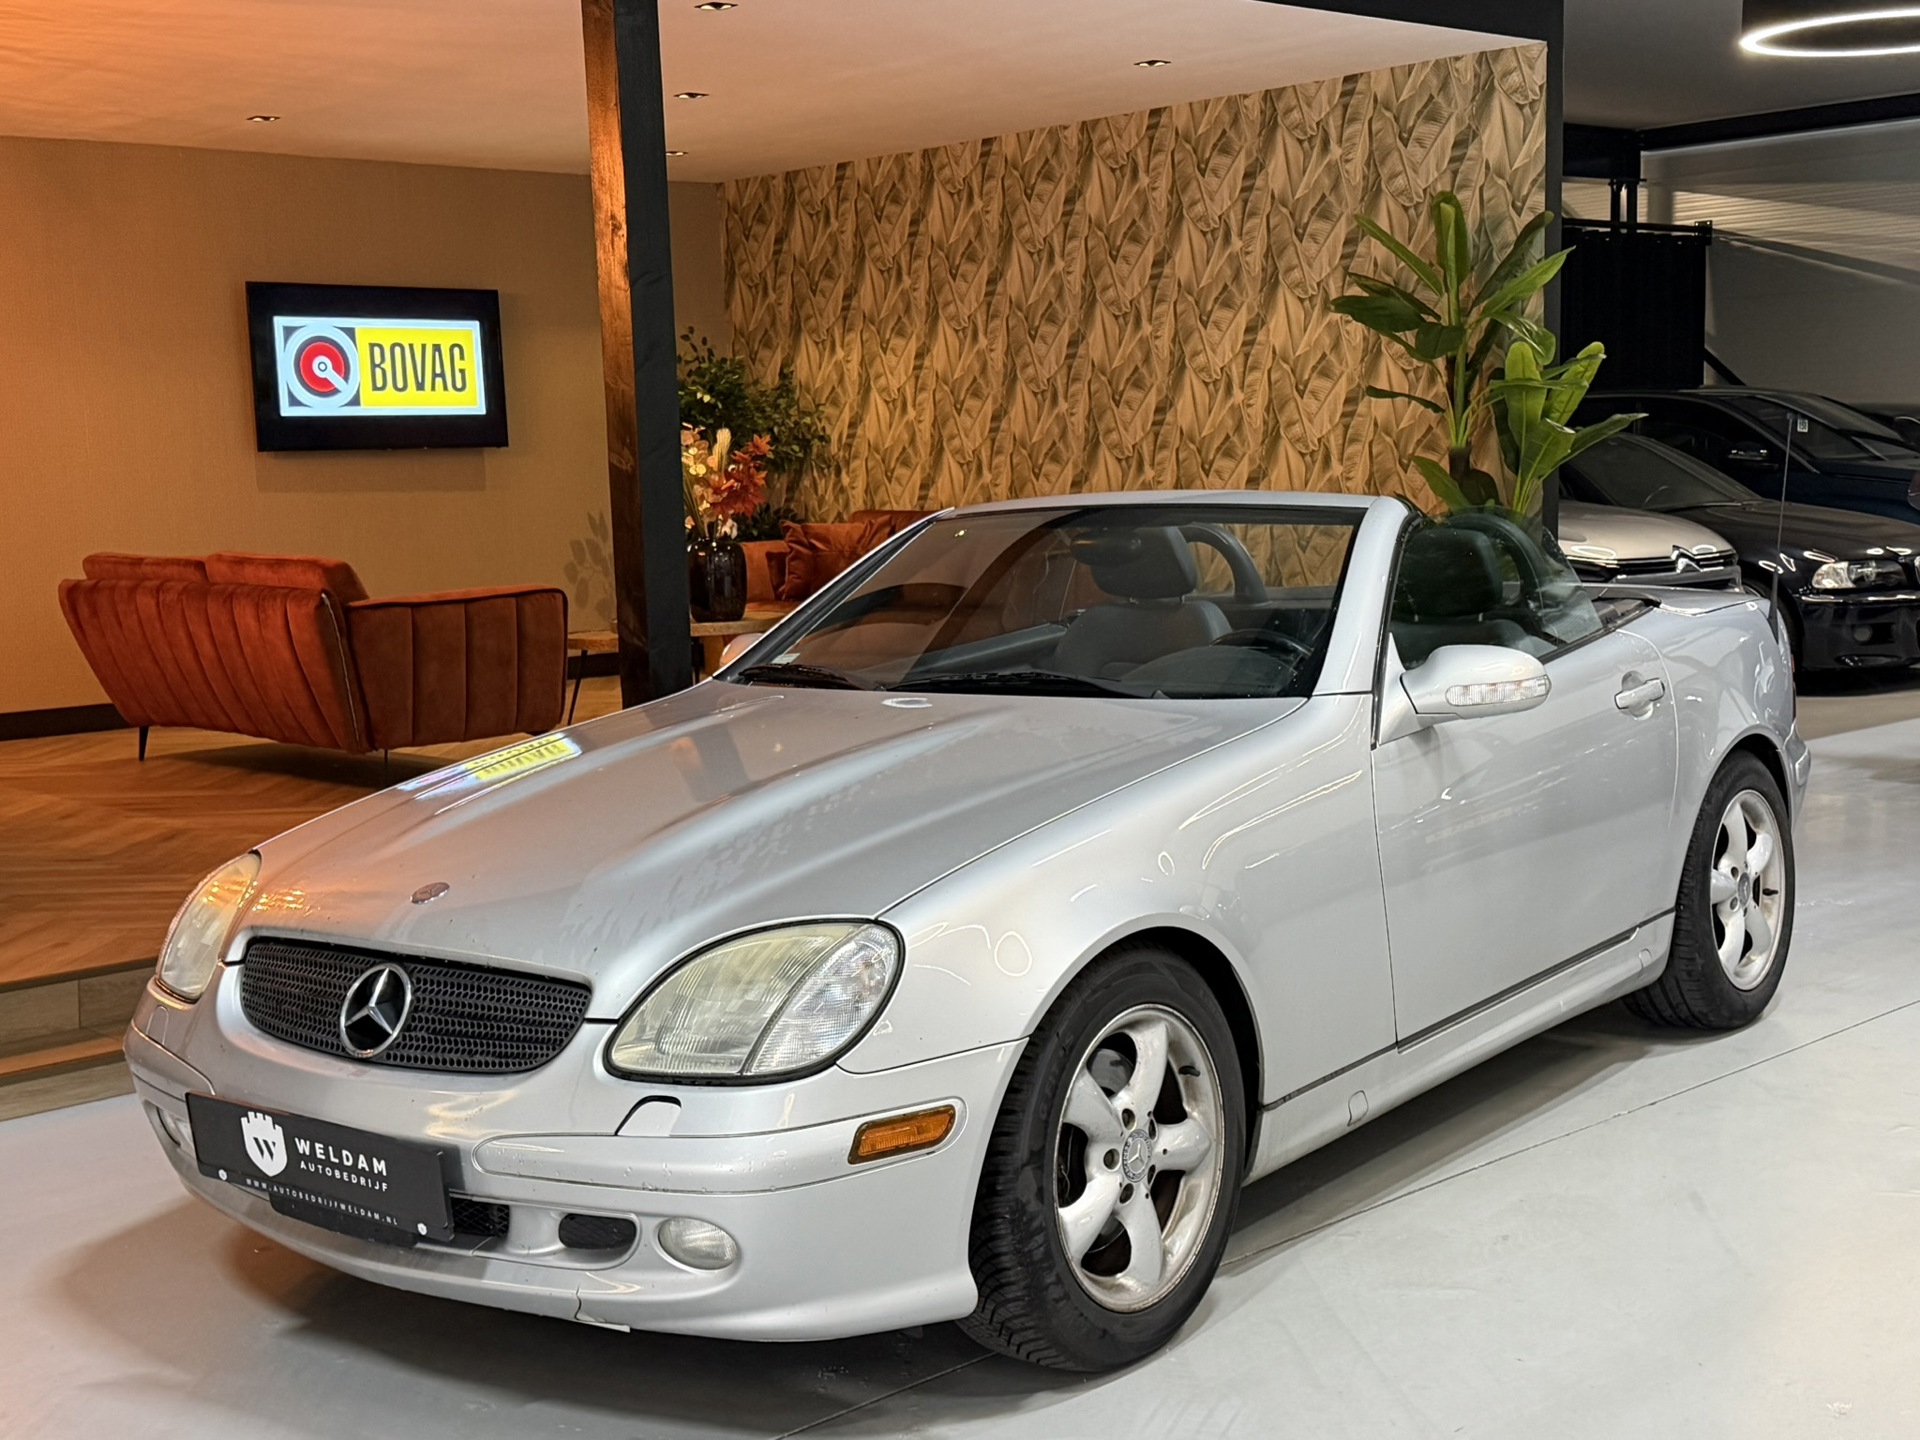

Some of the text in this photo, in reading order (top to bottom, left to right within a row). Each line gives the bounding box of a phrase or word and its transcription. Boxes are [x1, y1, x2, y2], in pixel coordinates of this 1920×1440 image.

[368, 342, 467, 392] BOVAG
[294, 1137, 388, 1176] WELDAM
[300, 1161, 389, 1192] AUTOBEDRIJF
[246, 1178, 398, 1226] WWW.AUTOBEDRIJFWELDAM.NL
